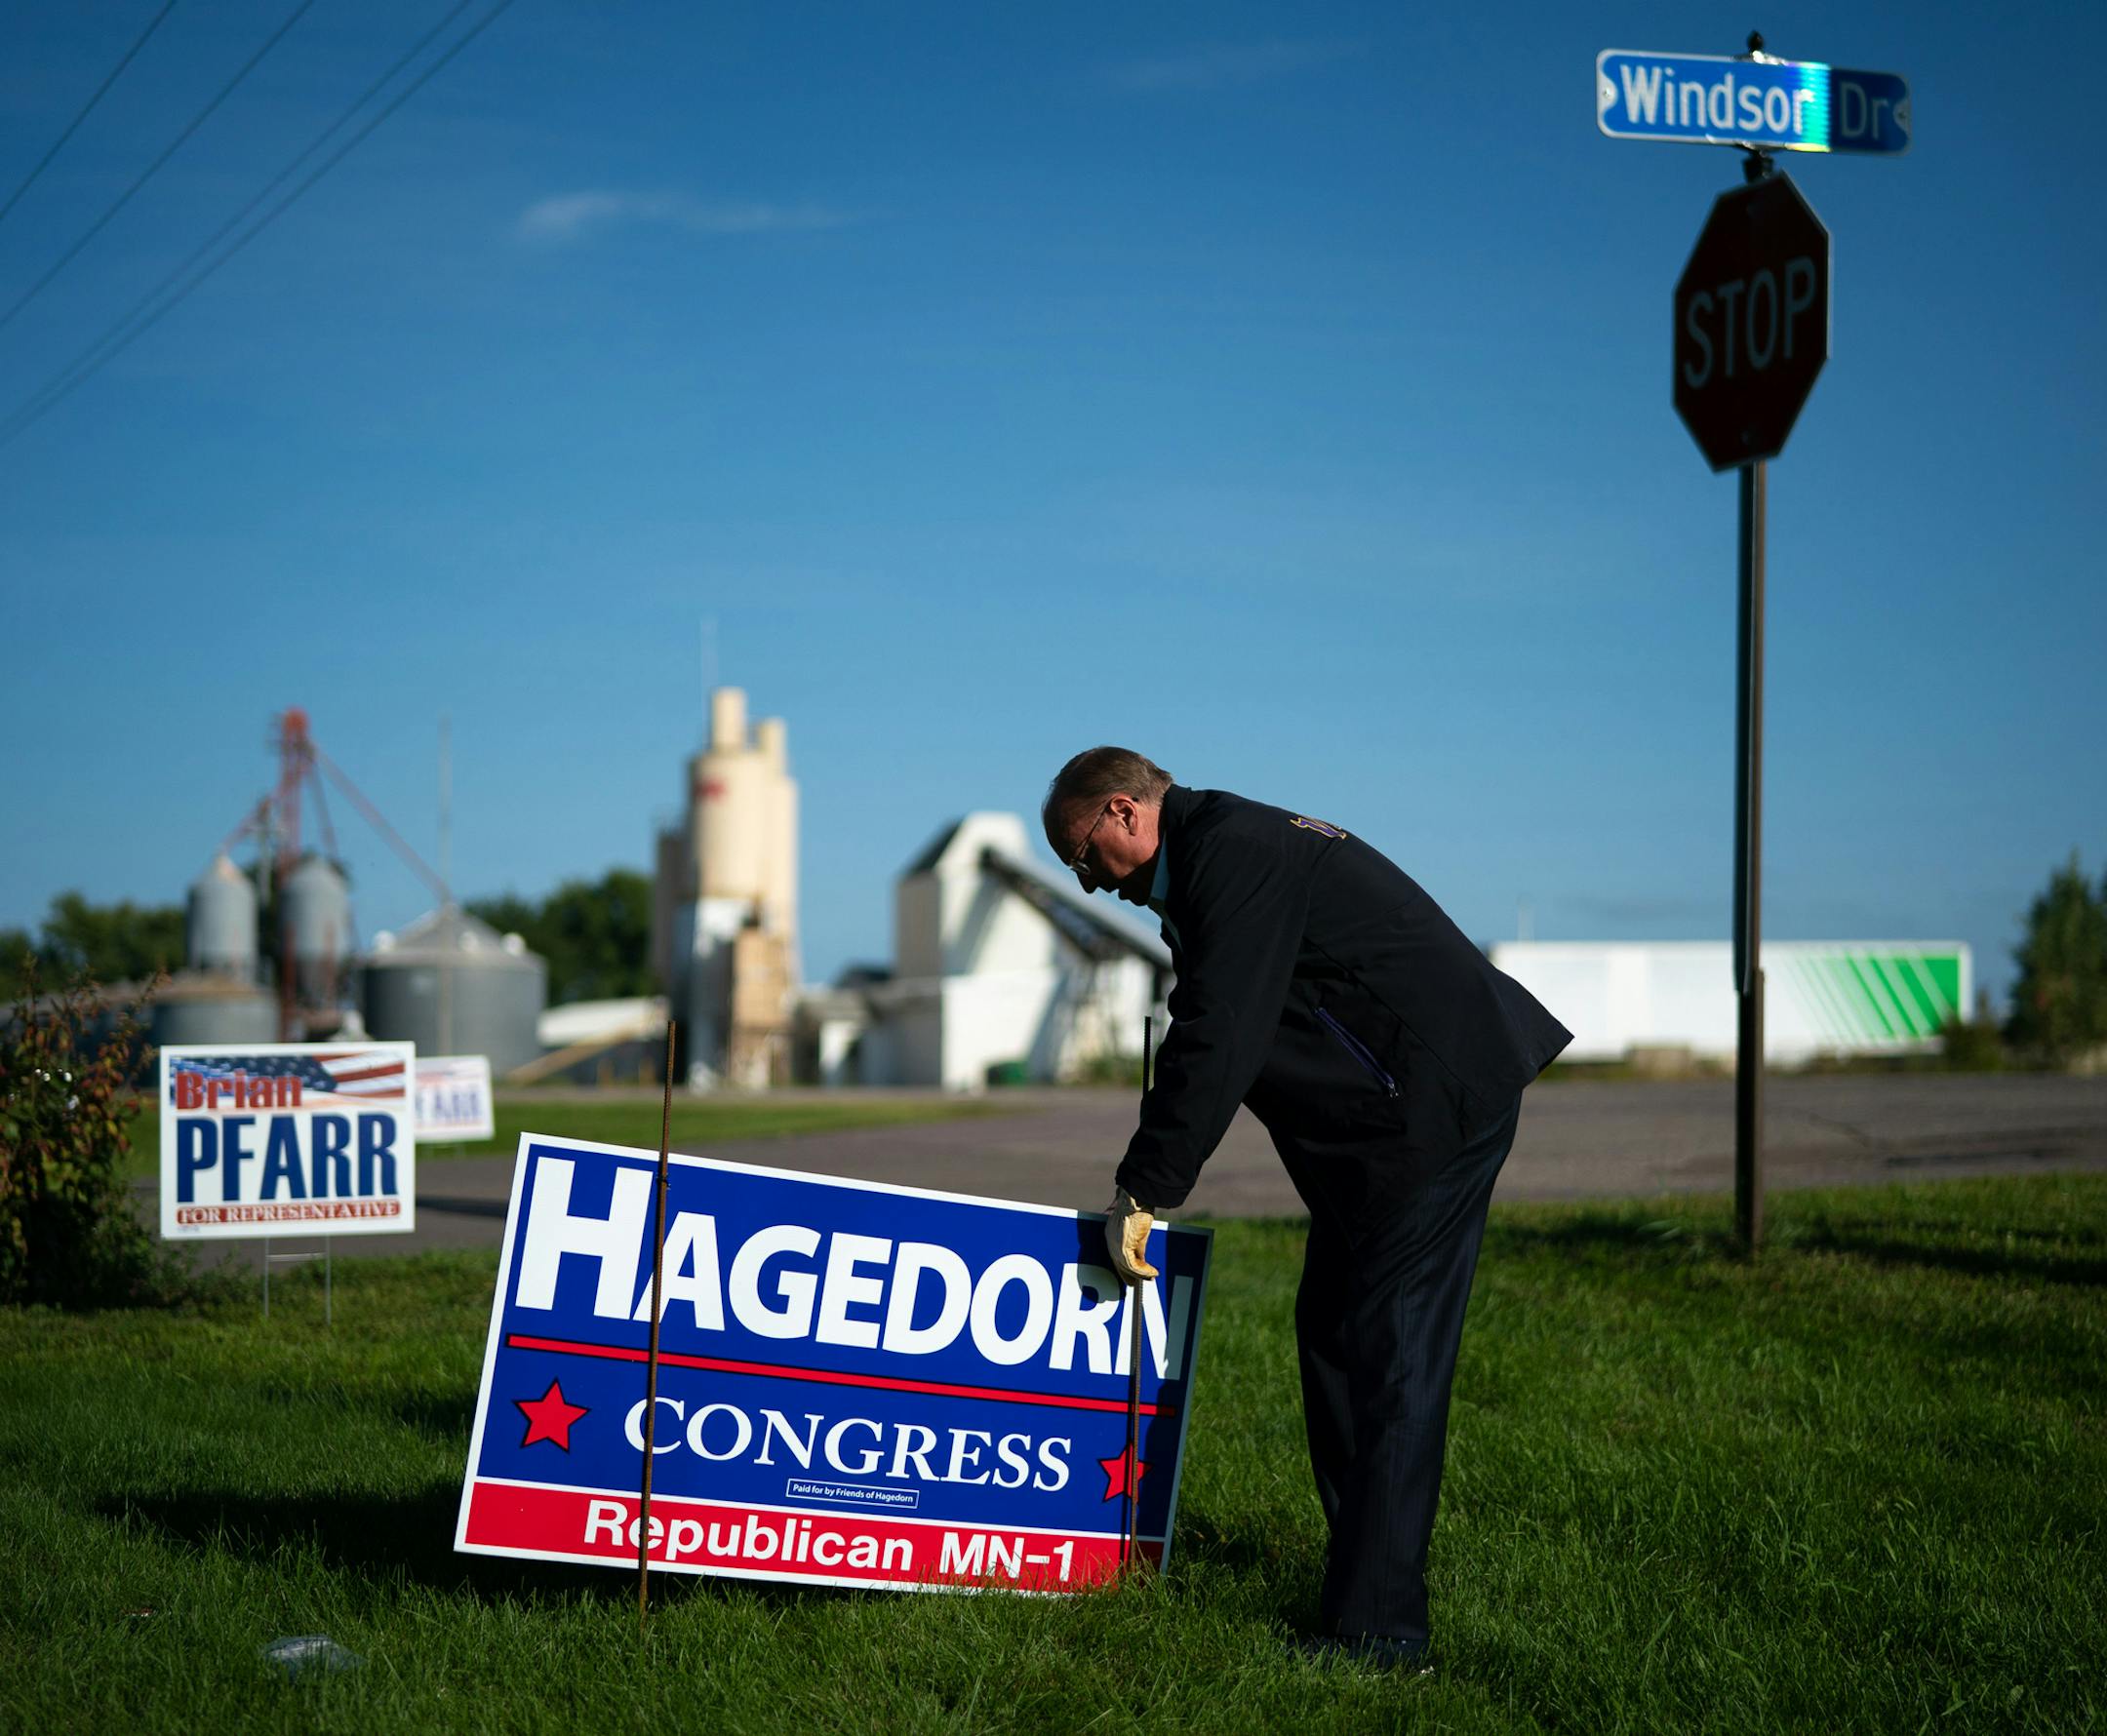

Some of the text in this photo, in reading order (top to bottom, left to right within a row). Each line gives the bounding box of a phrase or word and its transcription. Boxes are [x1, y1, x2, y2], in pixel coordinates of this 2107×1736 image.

[1619, 63, 1888, 138] Windsor Dr
[1684, 256, 1816, 389] STOP
[176, 1068, 303, 1110] Brian
[177, 1113, 398, 1203] PFARR
[180, 1201, 399, 1224] FOR REPRESENTATIVE
[515, 1156, 1194, 1381] HAGEDORN
[624, 1396, 1071, 1492] CONGRESS
[792, 1483, 914, 1503] Paid for by Friends of Hagedorn
[583, 1499, 1074, 1582] Republican MN-1
